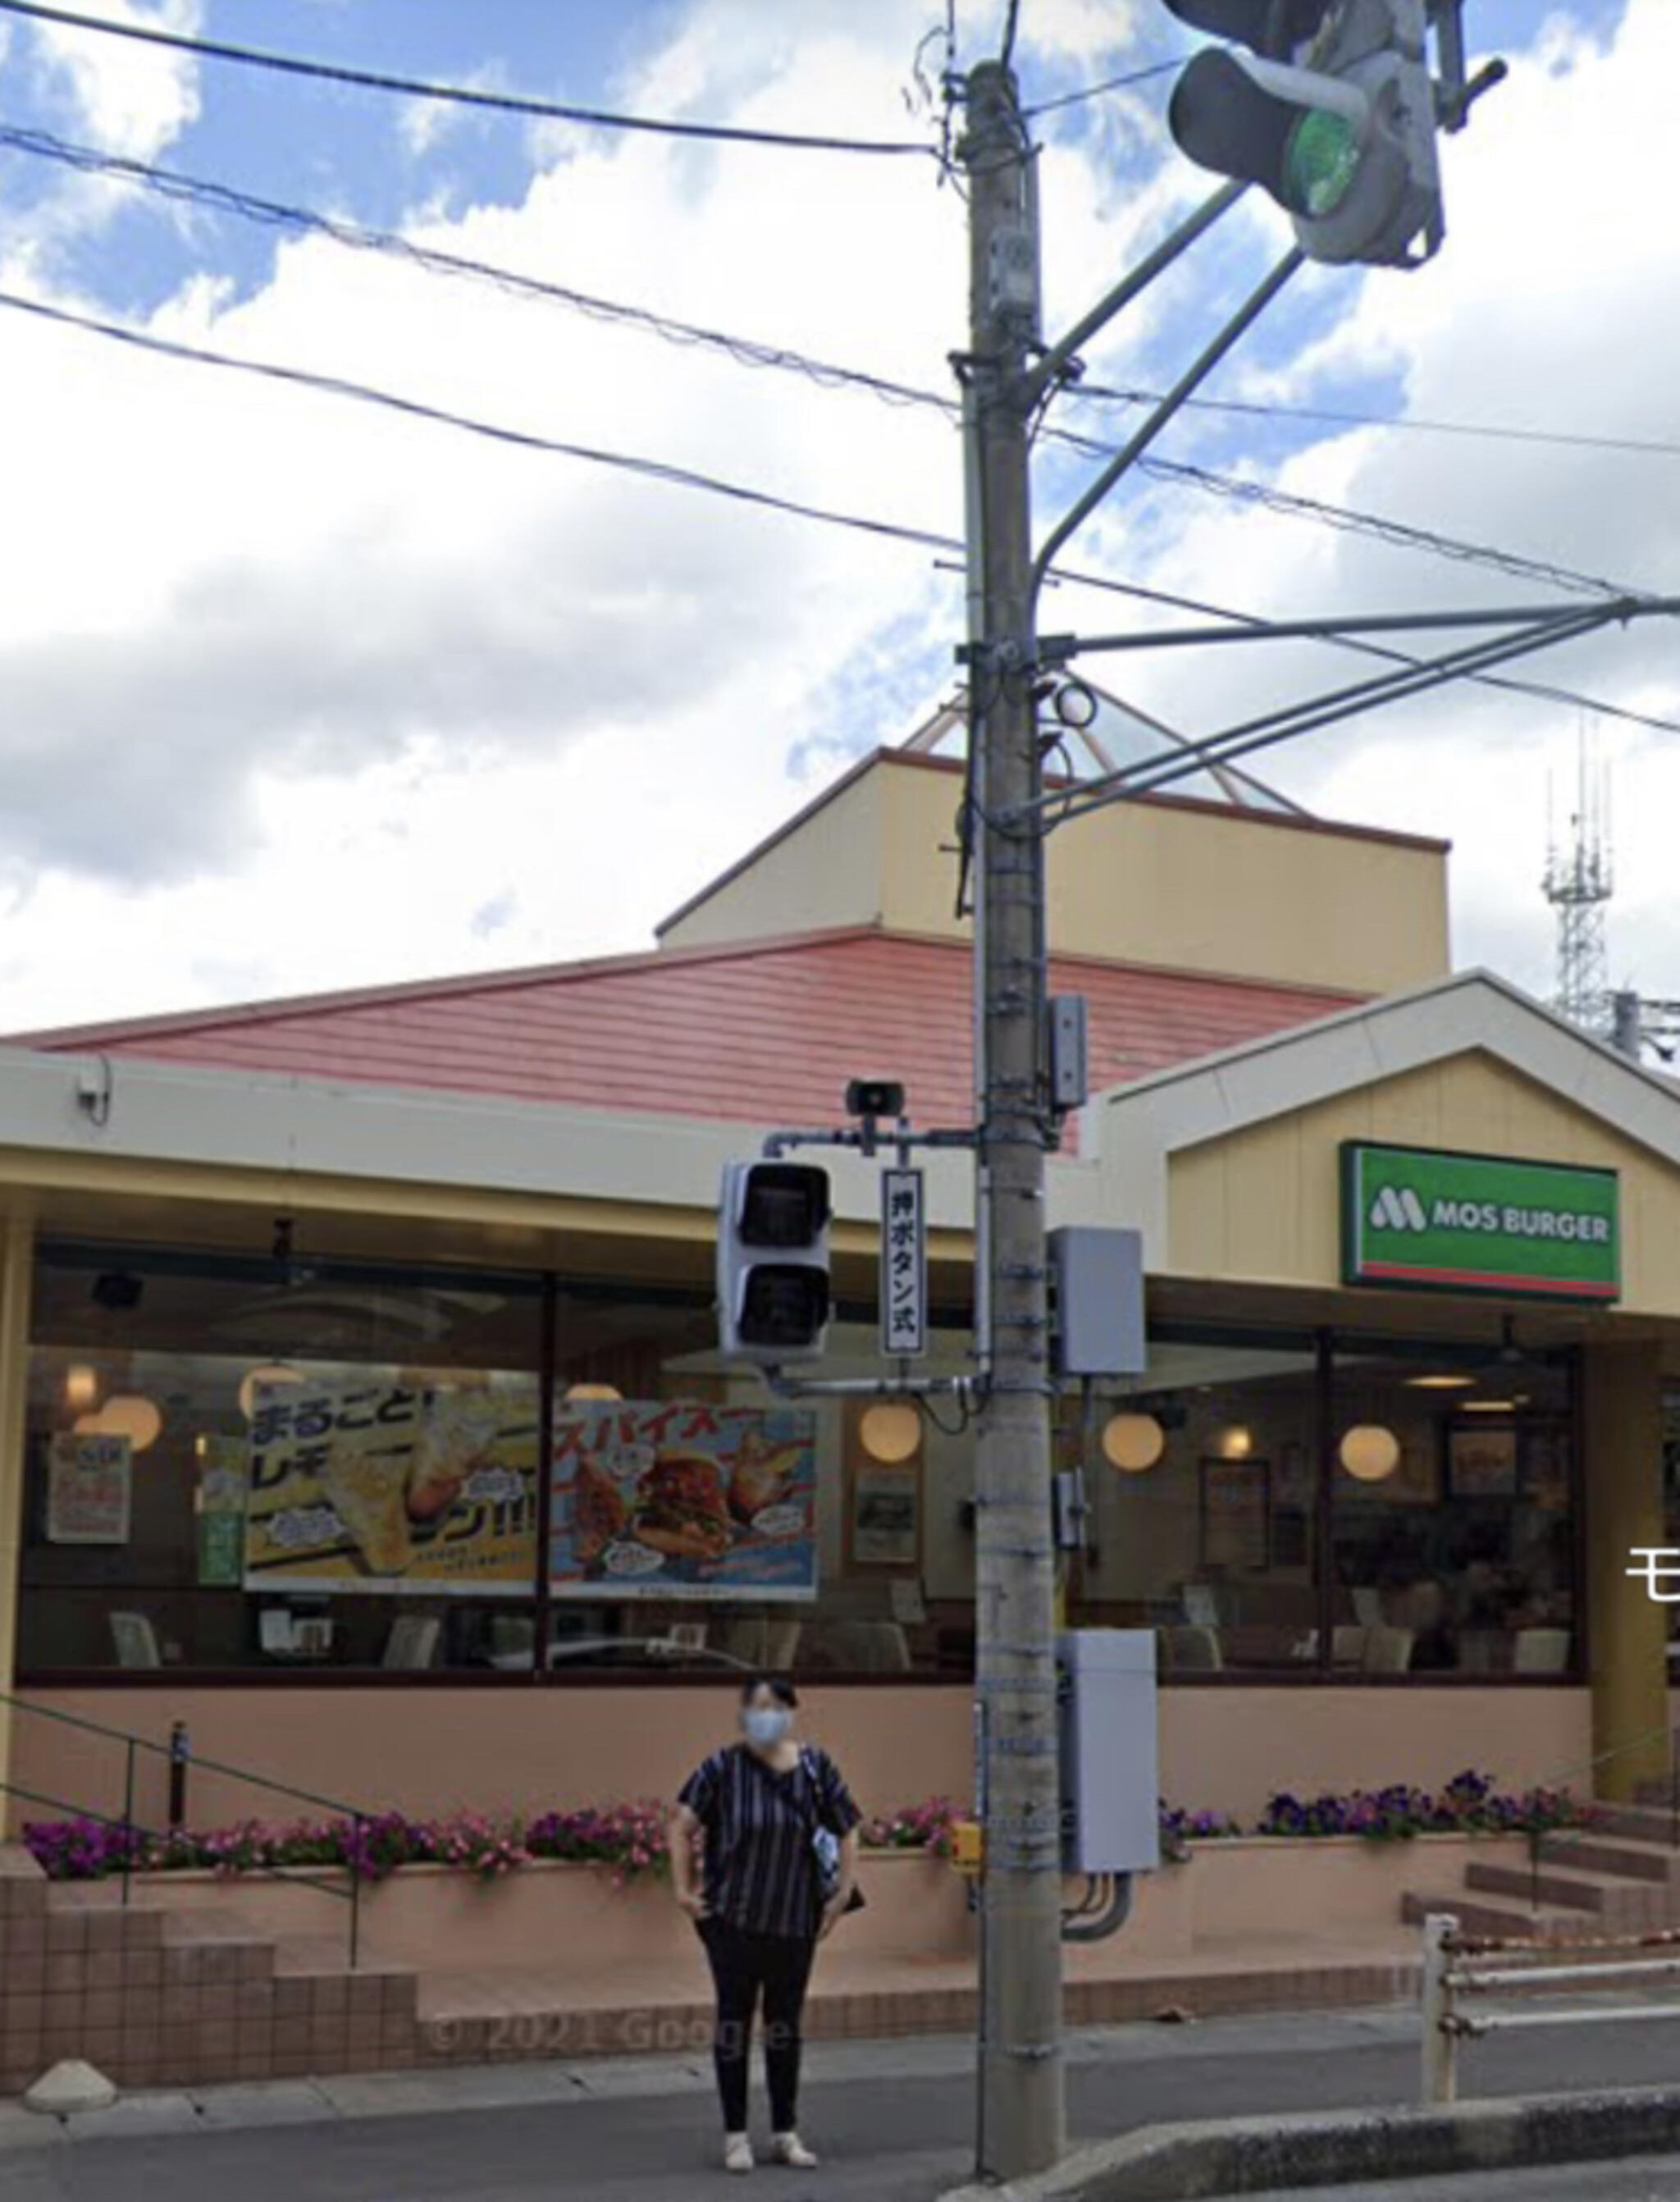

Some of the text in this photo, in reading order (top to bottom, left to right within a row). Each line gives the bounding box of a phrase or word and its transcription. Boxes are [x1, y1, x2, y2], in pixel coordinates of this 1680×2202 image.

[891, 1191, 915, 1334] 押ボタン式
[1433, 1199, 1609, 1241] MOS BURGER
